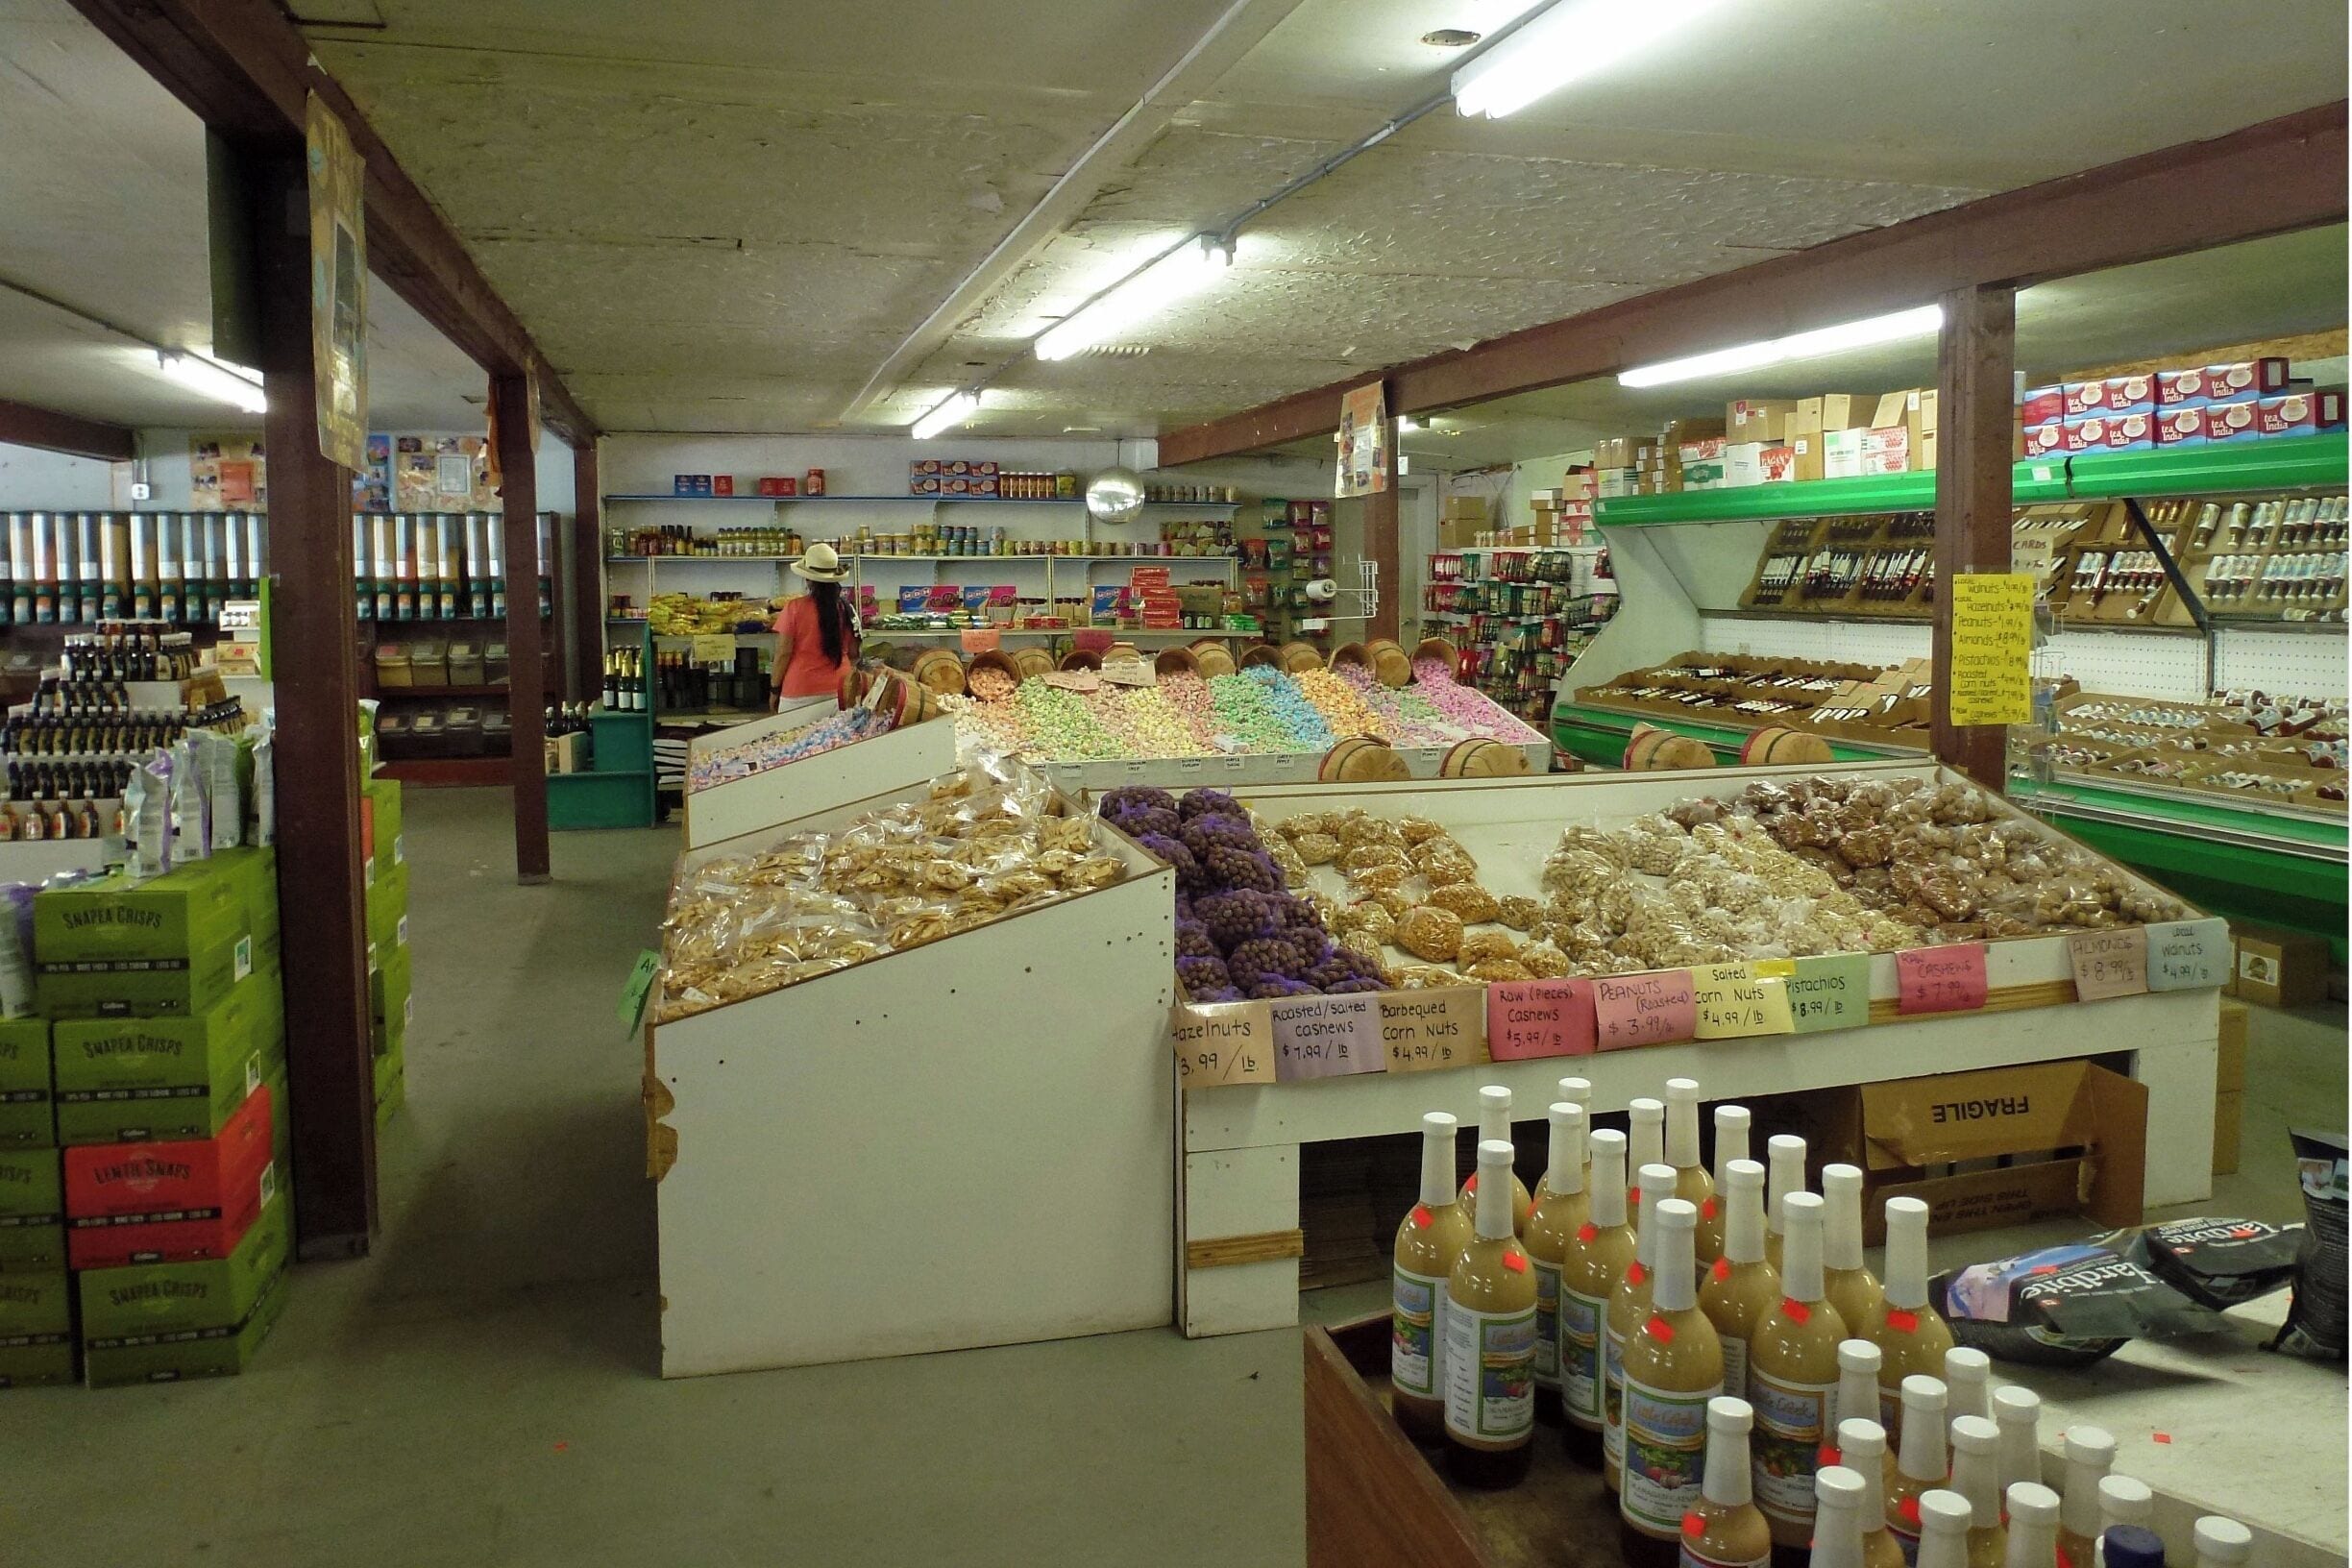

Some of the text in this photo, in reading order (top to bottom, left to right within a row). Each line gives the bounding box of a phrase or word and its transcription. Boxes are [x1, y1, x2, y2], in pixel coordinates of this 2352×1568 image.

[2013, 539, 2046, 551] CARDS
[61, 905, 162, 930] SNAPEA CRISPS
[1712, 967, 1747, 982] Salted
[1499, 990, 1524, 1002] Raw
[1599, 980, 1662, 1002] PEANUTS
[1733, 988, 1765, 1001] Nuts
[1382, 999, 1447, 1020] Barbequed
[1426, 1021, 1458, 1037] Nuts
[82, 1034, 183, 1059] SNAPEA CRISPS
[1931, 1095, 2030, 1123] FRAGILE
[145, 1158, 191, 1180] SNAPS
[1958, 1193, 1994, 1207] SIDE
[1997, 1188, 2029, 1200] THIS
